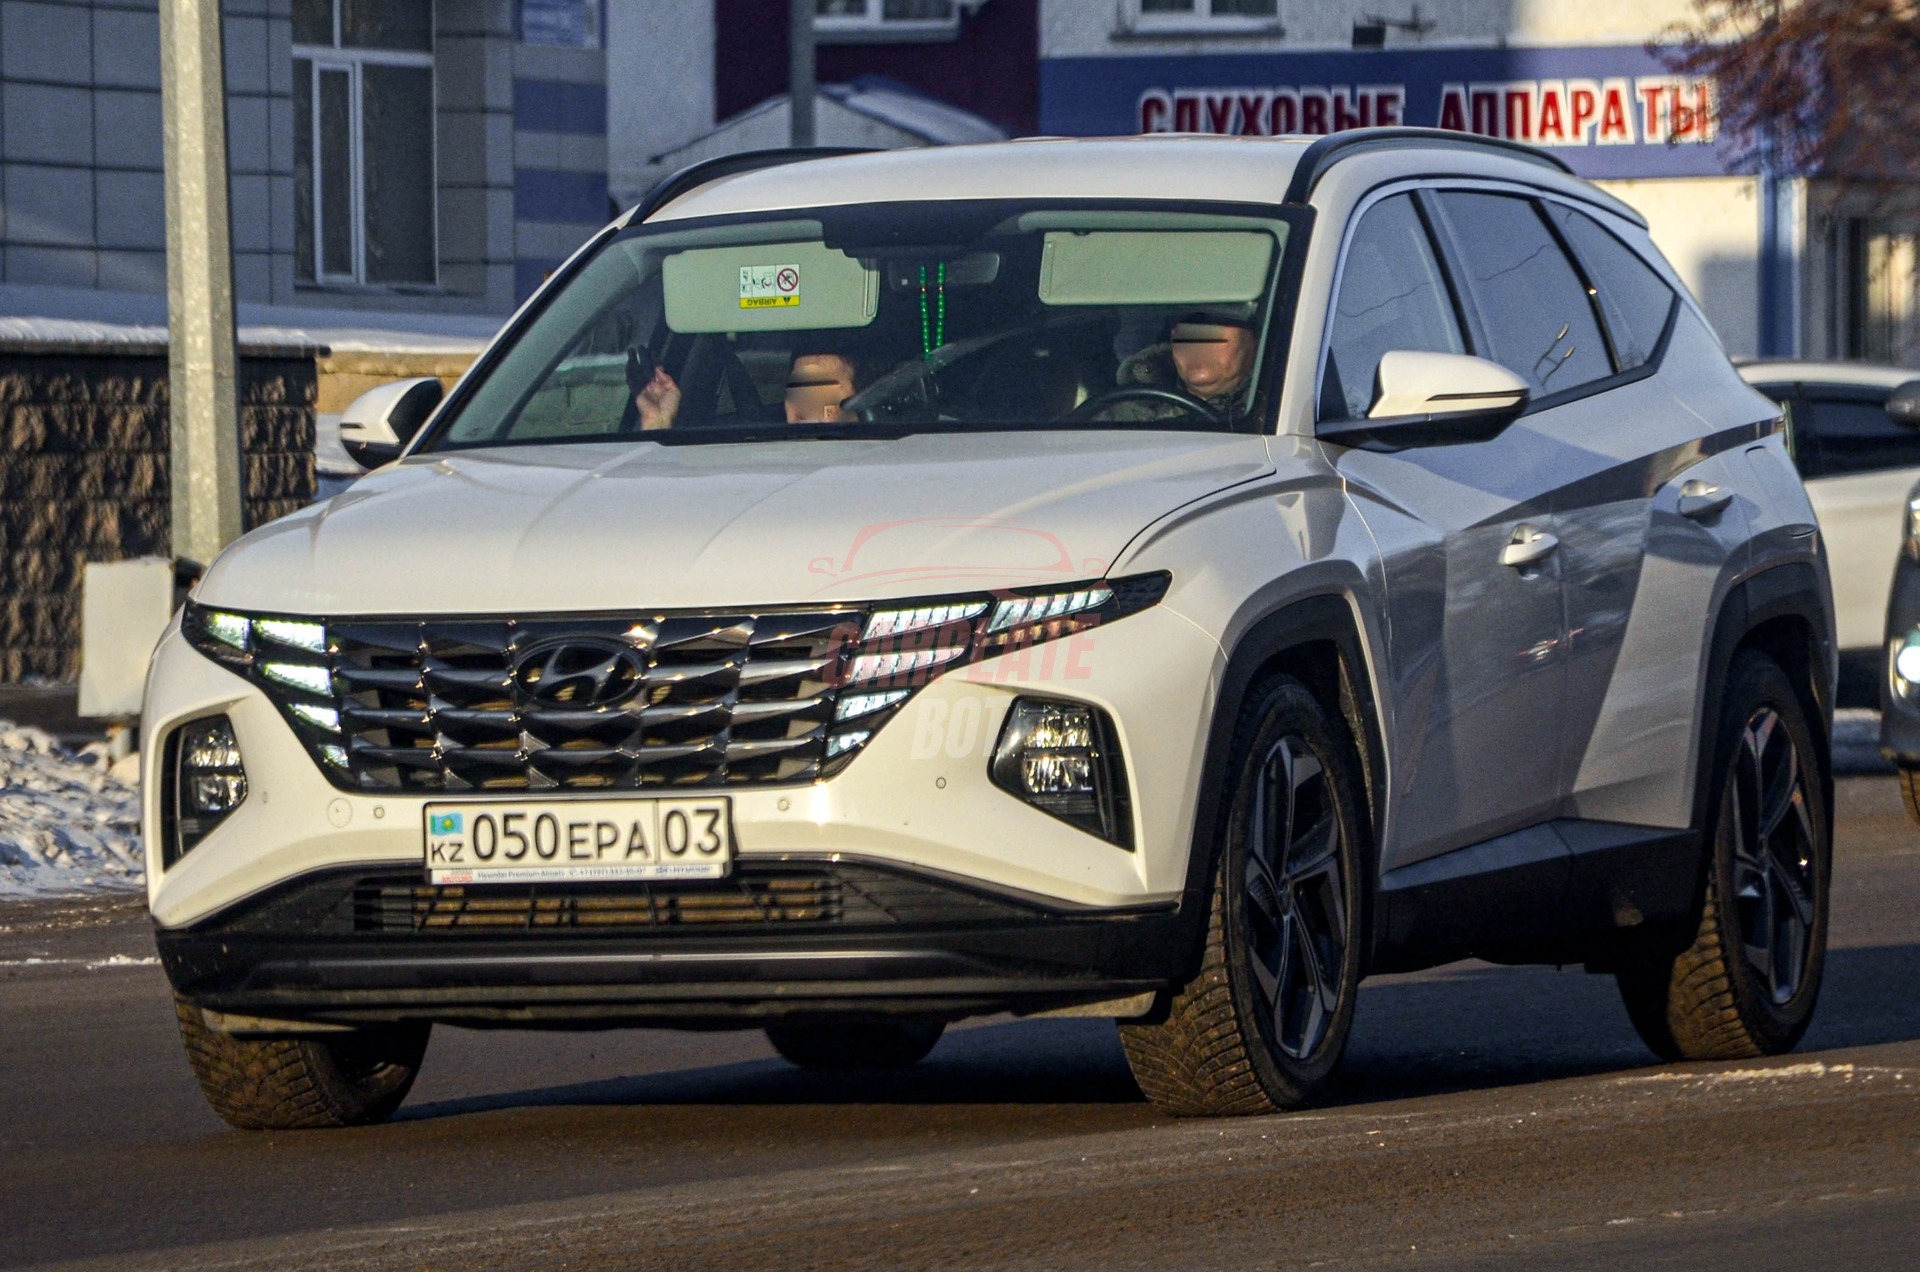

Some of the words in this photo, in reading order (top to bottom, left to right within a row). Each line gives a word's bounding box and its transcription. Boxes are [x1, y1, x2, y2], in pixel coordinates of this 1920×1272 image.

[1140, 89, 1403, 135] СЛУХОВЫЕ
[1438, 80, 1714, 143] АППАРАТЫ
[746, 298, 777, 306] AIRBAG
[664, 808, 722, 857] 03
[430, 842, 465, 863] KZ
